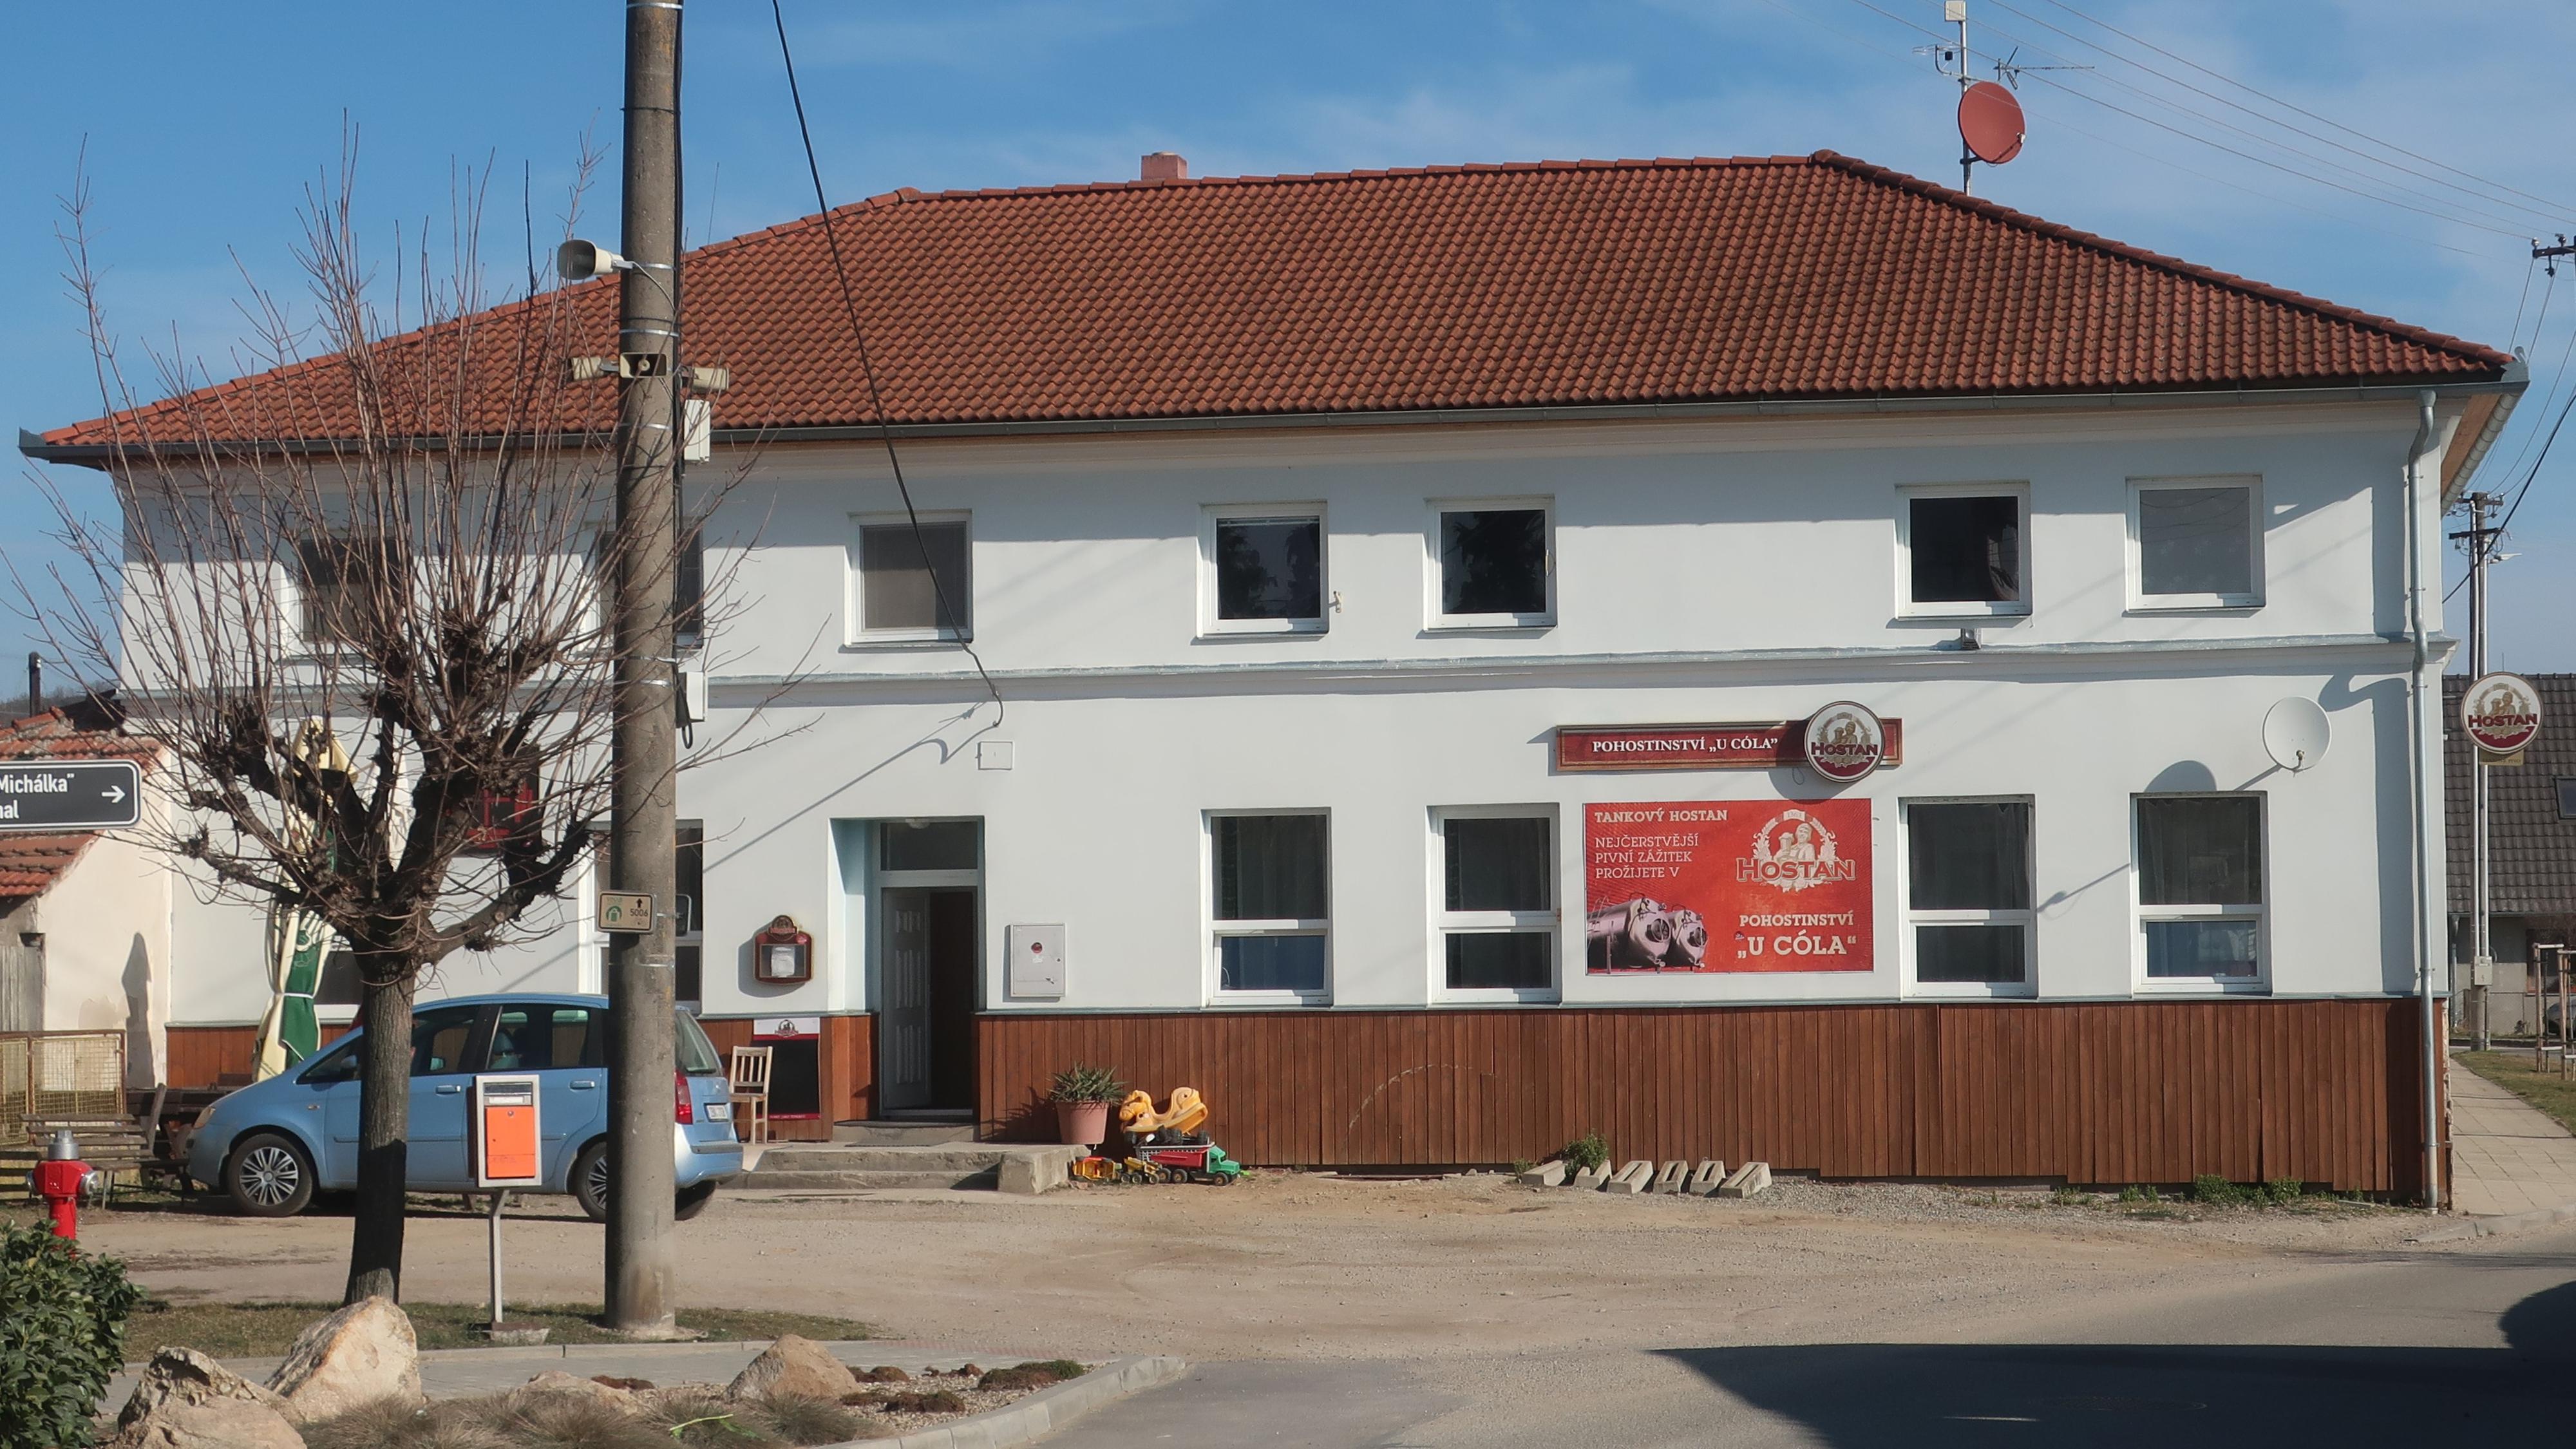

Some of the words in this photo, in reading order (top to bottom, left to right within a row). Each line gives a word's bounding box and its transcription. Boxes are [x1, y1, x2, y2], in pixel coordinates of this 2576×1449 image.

[2468, 714, 2537, 728] HOSTAN
[1593, 737, 1705, 752] POHOSTINSTVÍ
[1811, 741, 1878, 755] HOSTAN
[1595, 808, 1665, 822] TANKOVÝ
[1669, 810, 1728, 822] HOSTAN
[1595, 833, 1699, 848] NEJČERSTVĚJŠÍ
[1595, 849, 1634, 864] PIVNÍ
[1638, 849, 1692, 863] ZÁŽITEK
[1596, 865, 1665, 879] PROŽIJETE
[1669, 867, 1680, 877] V
[1736, 857, 1855, 882] HOSTAN
[630, 908, 649, 917] 5006
[1739, 909, 1853, 927] POHOSTINSTVÍ
